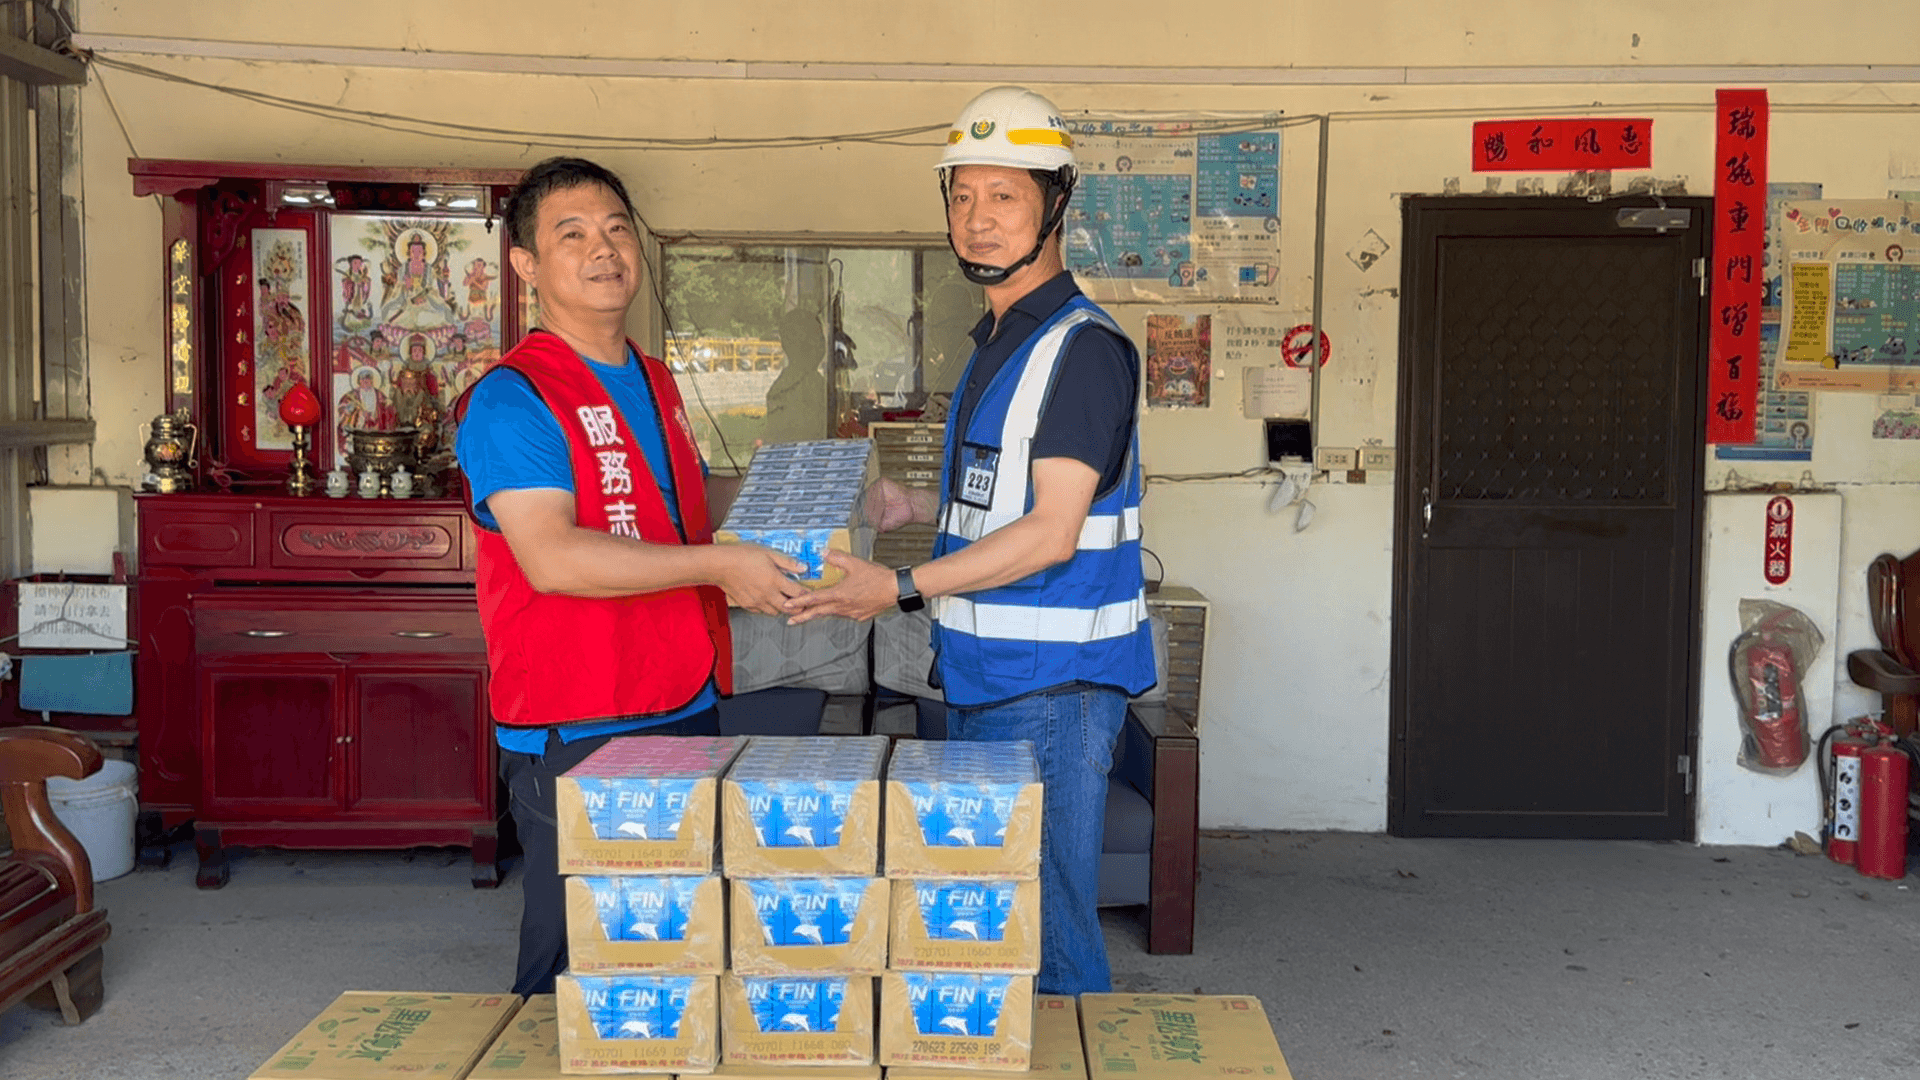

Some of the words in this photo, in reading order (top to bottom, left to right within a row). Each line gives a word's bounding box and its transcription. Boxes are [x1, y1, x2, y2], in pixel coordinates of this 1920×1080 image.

[967, 472, 990, 492] 223
[1769, 521, 1788, 577] 滅火器
[617, 791, 655, 809] FIN
[666, 792, 687, 809] FI
[783, 795, 820, 812] FIN
[946, 796, 983, 814] FIN
[629, 891, 665, 908] FIN
[791, 894, 829, 911] FIN
[948, 890, 986, 906] FIN
[619, 989, 657, 1007] FIN
[778, 983, 816, 1000] FIN
[938, 986, 976, 1003] FIN
[912, 1040, 946, 1053] 270623
